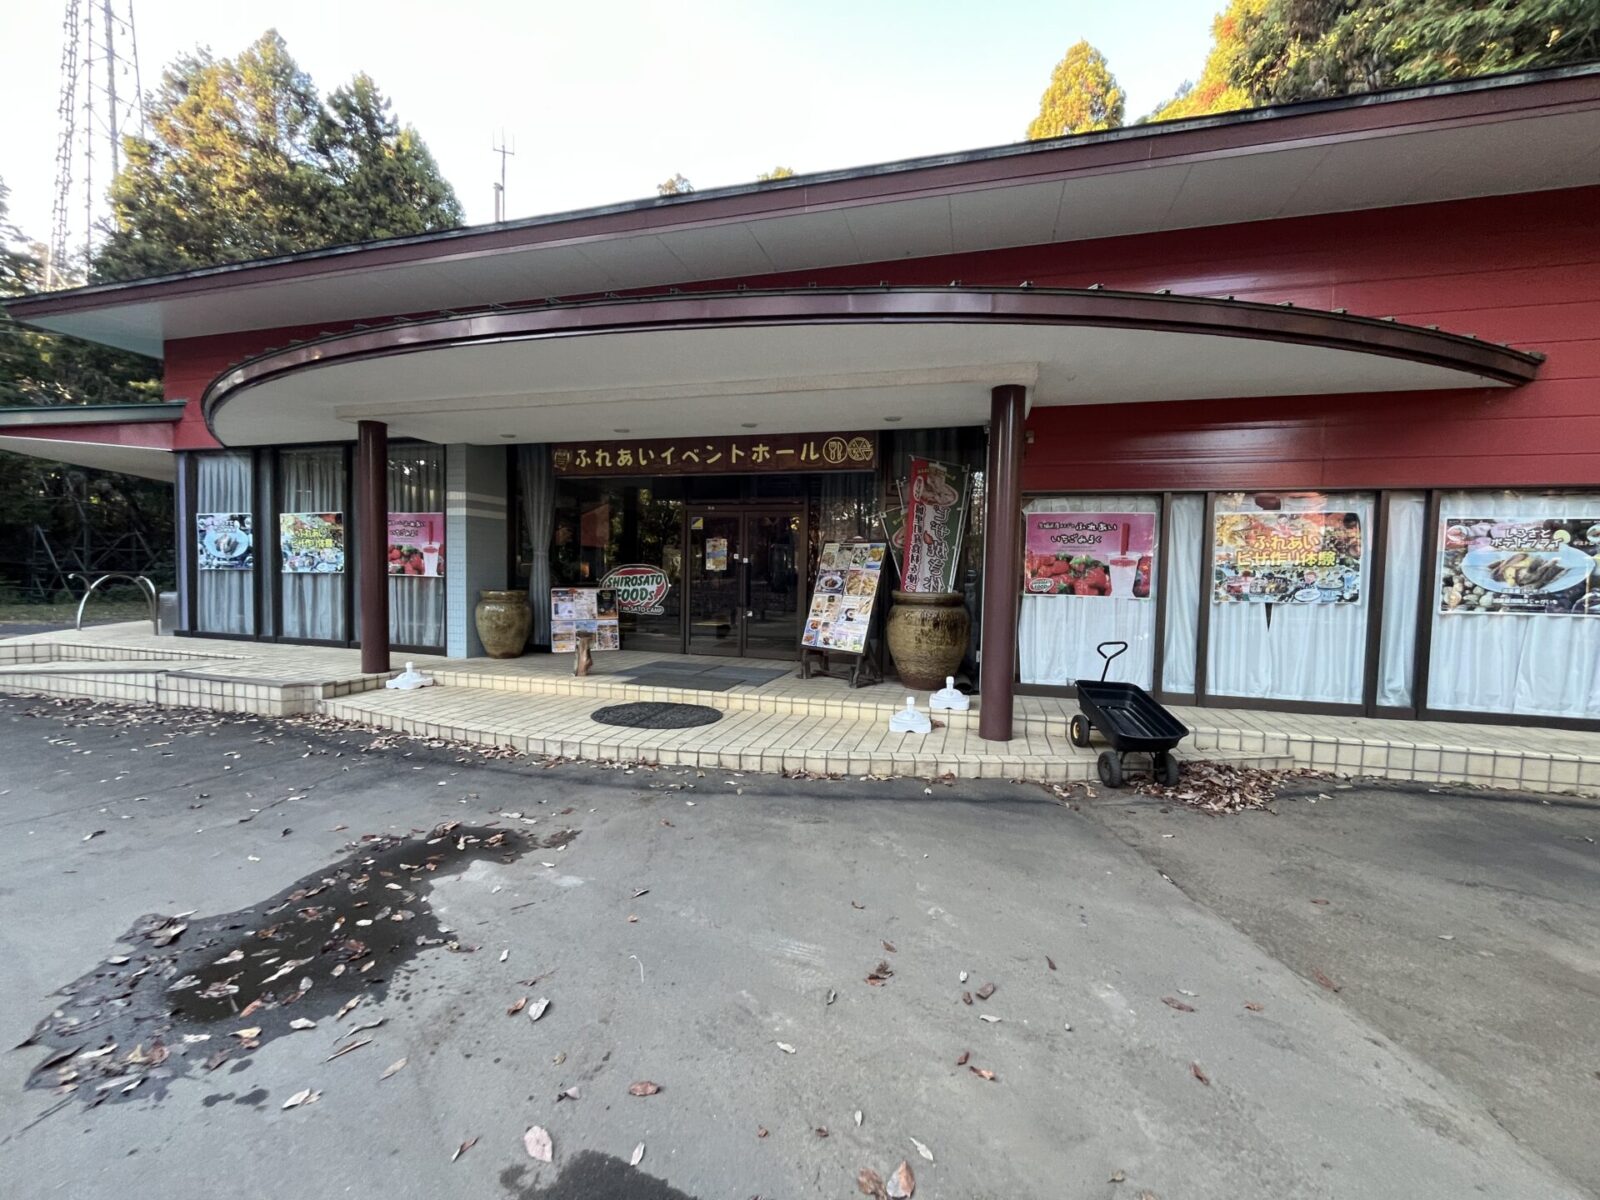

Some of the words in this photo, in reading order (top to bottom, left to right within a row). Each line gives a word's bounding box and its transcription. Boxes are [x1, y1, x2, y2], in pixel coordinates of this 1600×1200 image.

[575, 442, 820, 468] ふれあいイベントホール
[1253, 535, 1320, 550] ふれあい
[1489, 537, 1564, 548] ポテトフライ
[1236, 550, 1337, 567] ピザ作り体験
[607, 574, 663, 587] SHIROSATO
